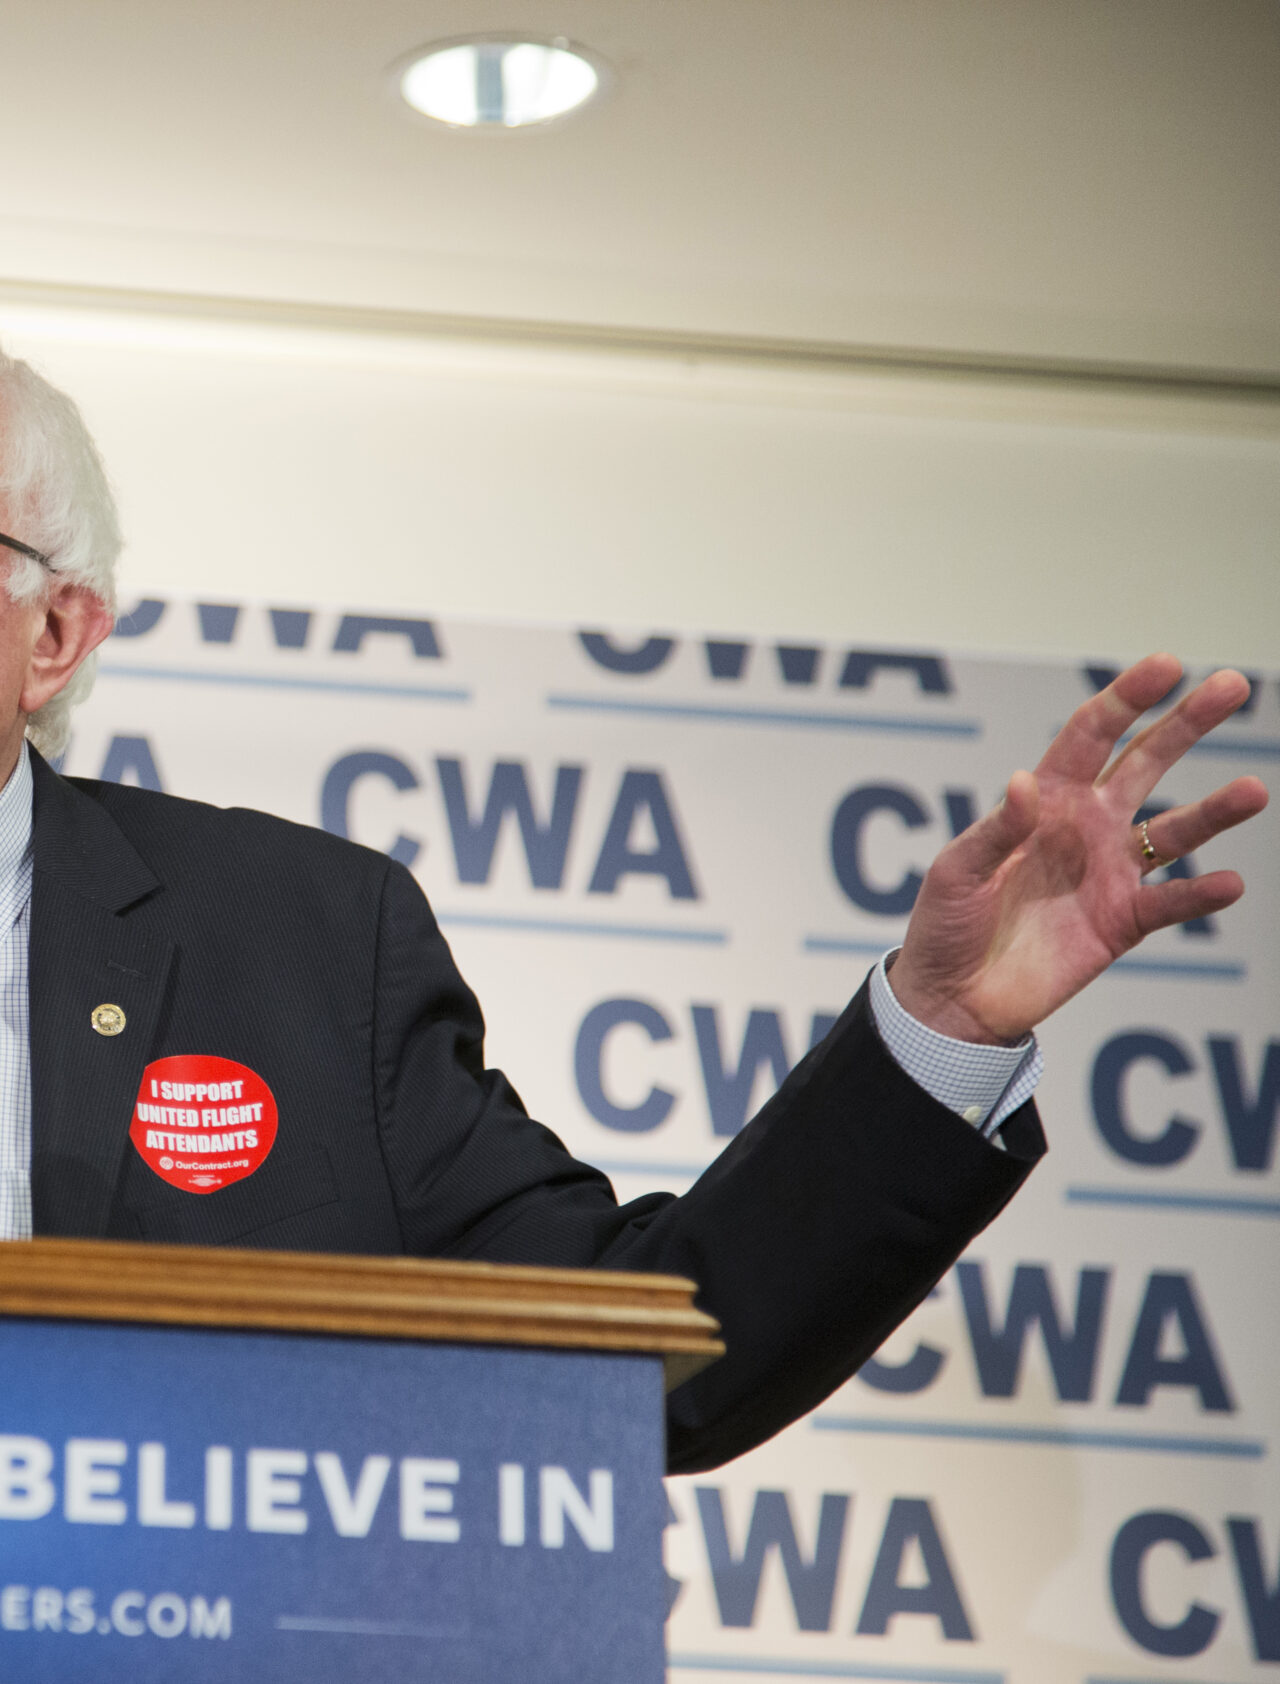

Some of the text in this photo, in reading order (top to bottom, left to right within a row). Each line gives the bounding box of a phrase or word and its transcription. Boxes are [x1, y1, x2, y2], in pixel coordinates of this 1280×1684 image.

[320, 748, 701, 901] CWA
[151, 1079, 244, 1102] I SUPPORT
[137, 1103, 263, 1128] UNITED FLIGHT
[146, 1129, 258, 1153] ATTENDANTS
[175, 1159, 249, 1170] OurContract.org
[499, 1463, 615, 1553] IN
